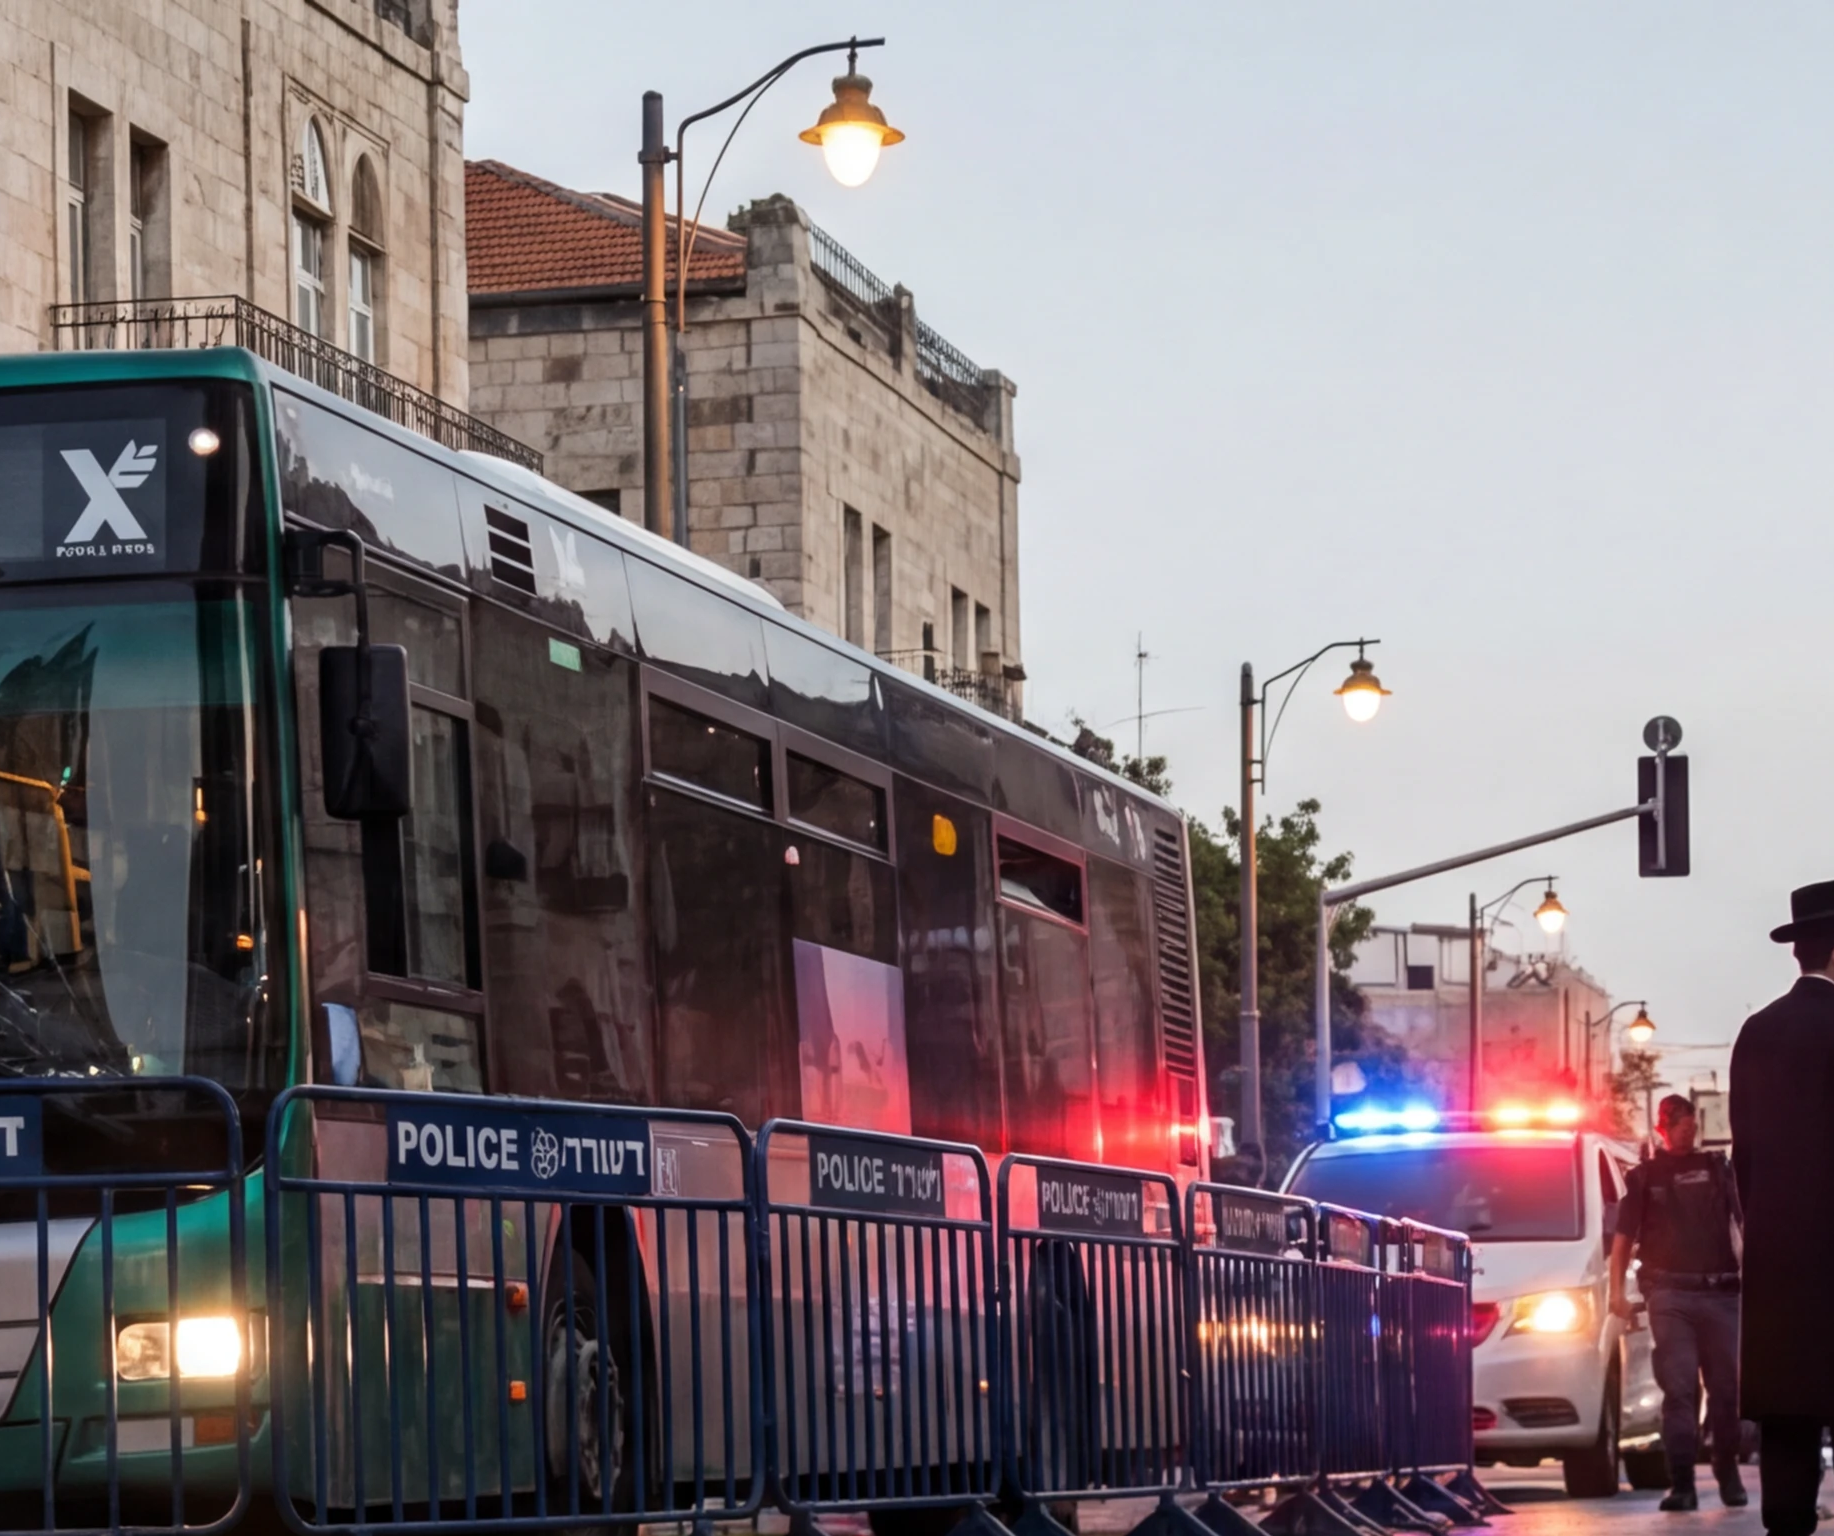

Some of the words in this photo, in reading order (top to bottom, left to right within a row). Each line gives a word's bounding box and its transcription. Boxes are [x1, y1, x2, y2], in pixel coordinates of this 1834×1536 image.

[396, 1121, 520, 1171] POLICE
[816, 1152, 885, 1194] POLICE
[1041, 1180, 1091, 1216] POLICE
